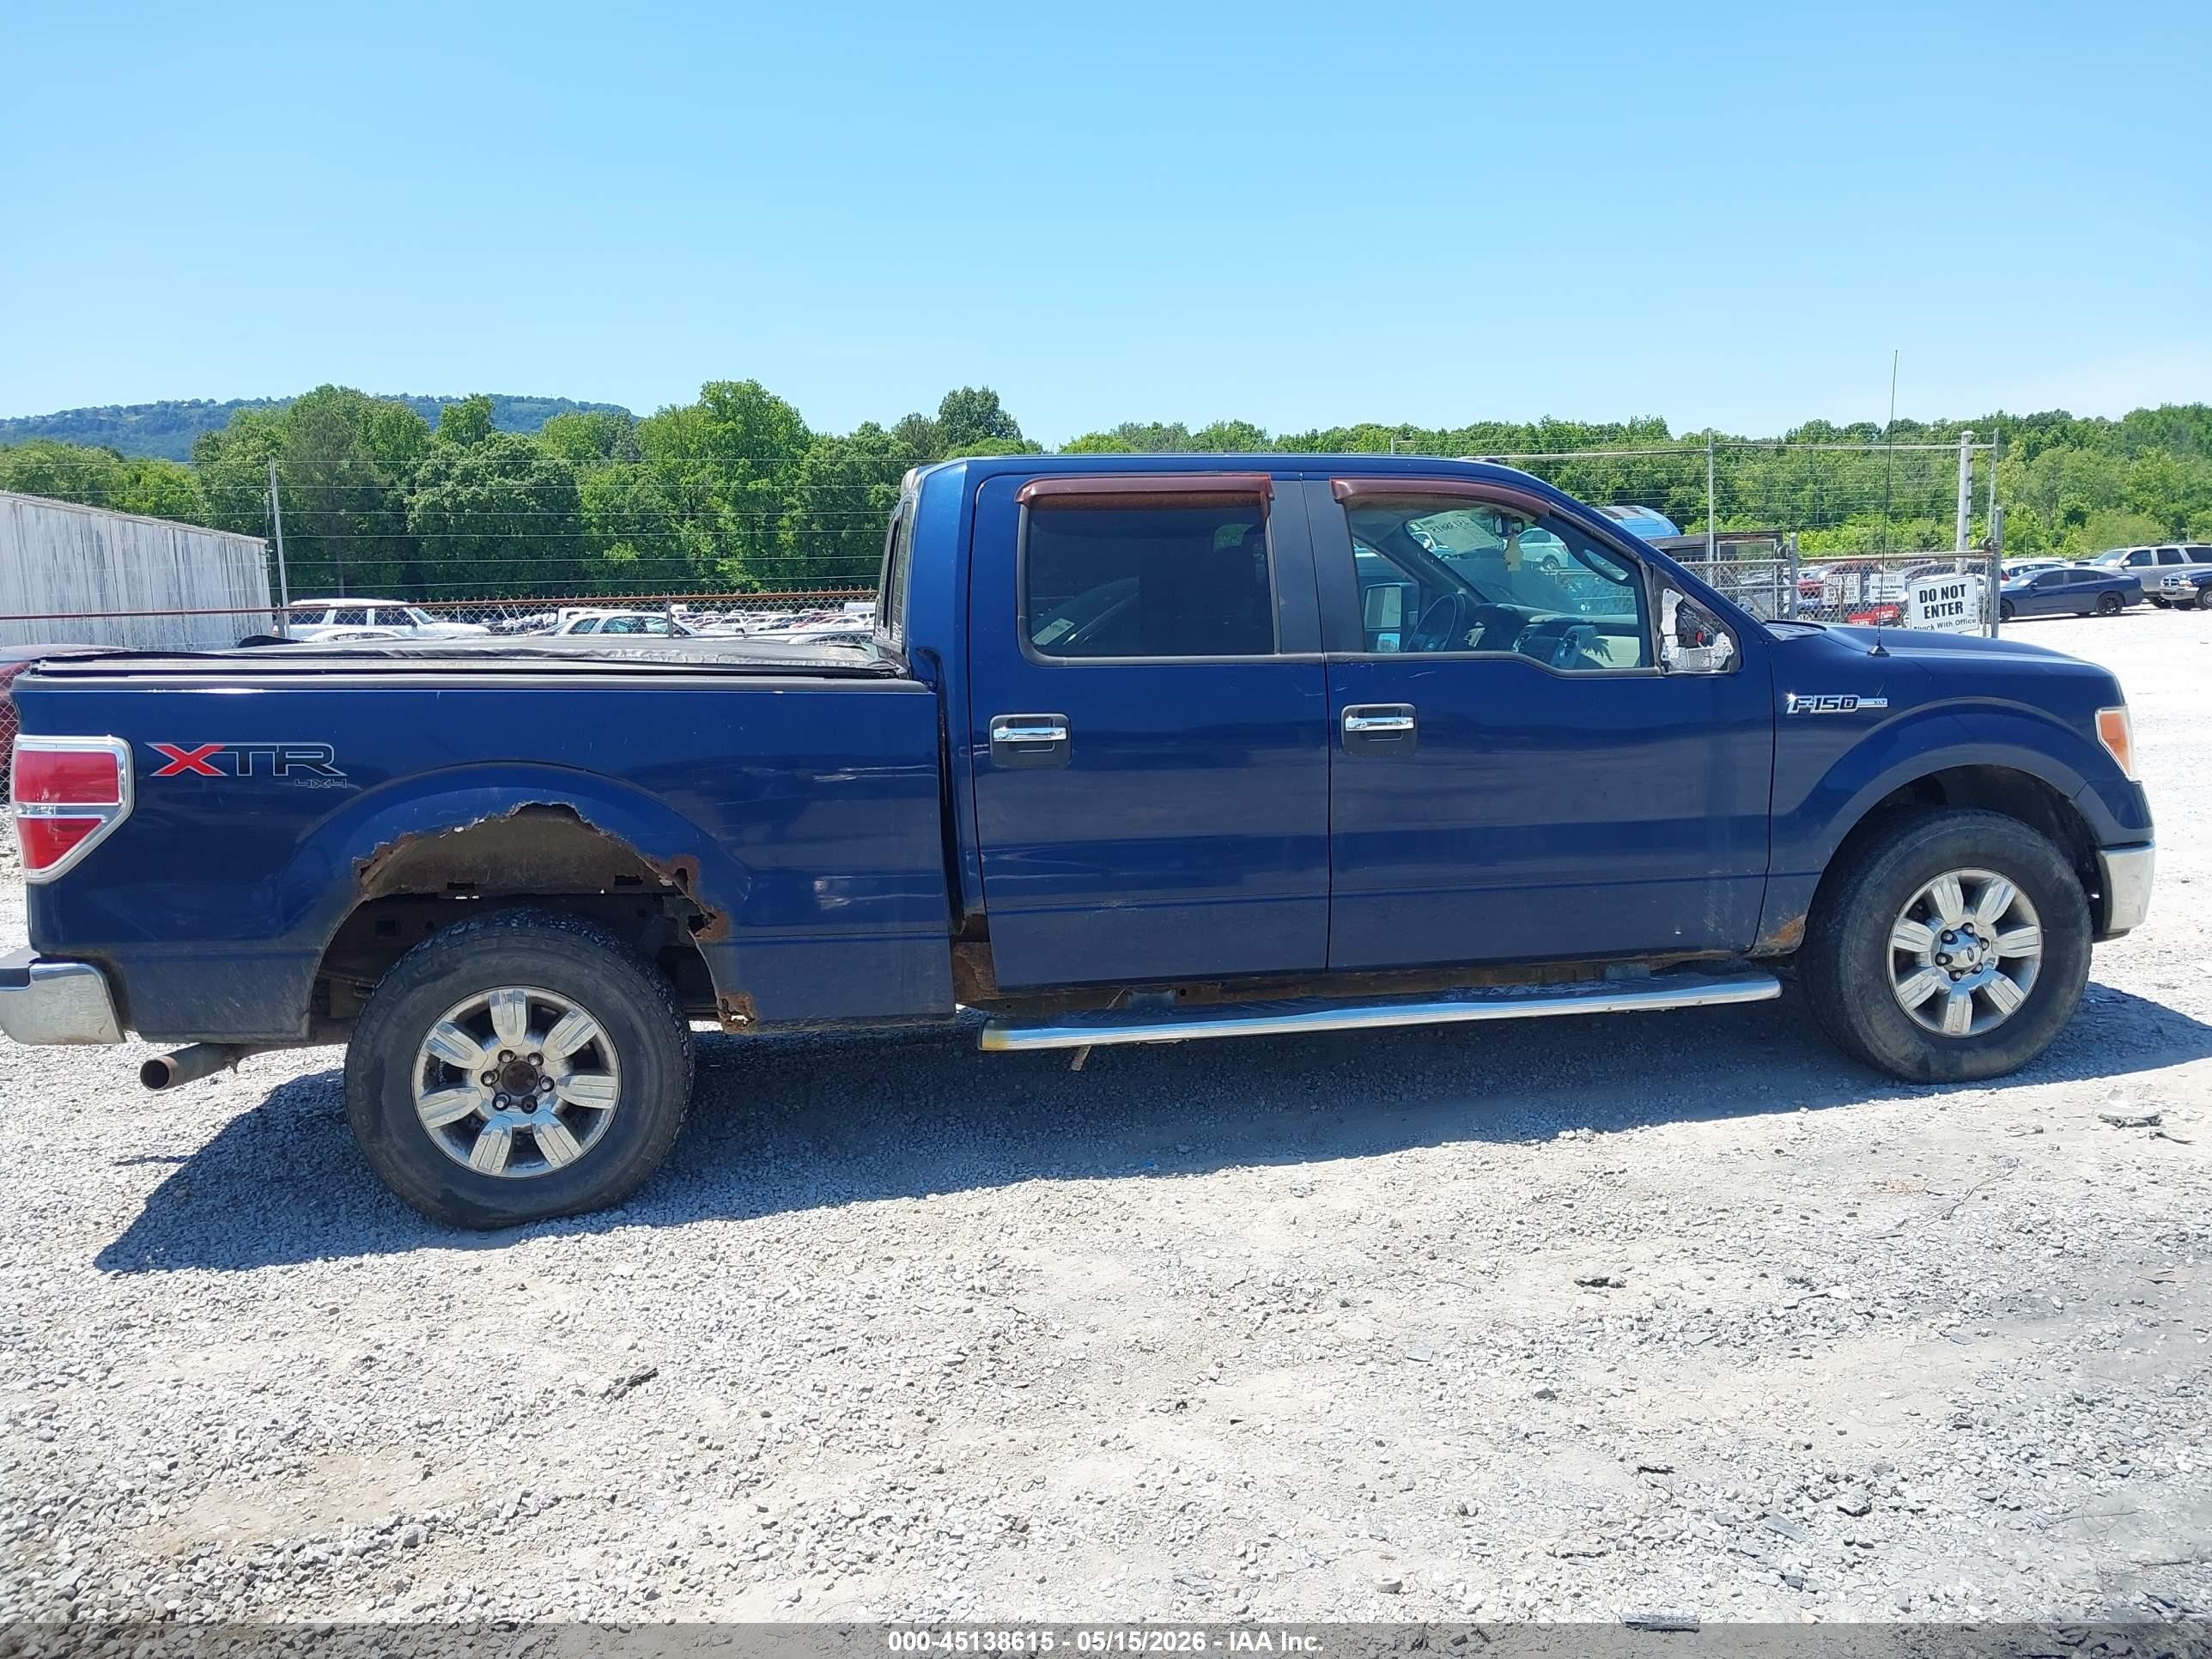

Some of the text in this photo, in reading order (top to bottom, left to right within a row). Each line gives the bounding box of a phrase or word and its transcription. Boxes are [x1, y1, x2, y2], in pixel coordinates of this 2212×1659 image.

[1919, 584, 1966, 604] DO NOT
[1923, 601, 1964, 619] ENTER
[1937, 621, 1953, 629] With
[1786, 694, 1861, 714] F-150
[144, 742, 348, 776] XTR
